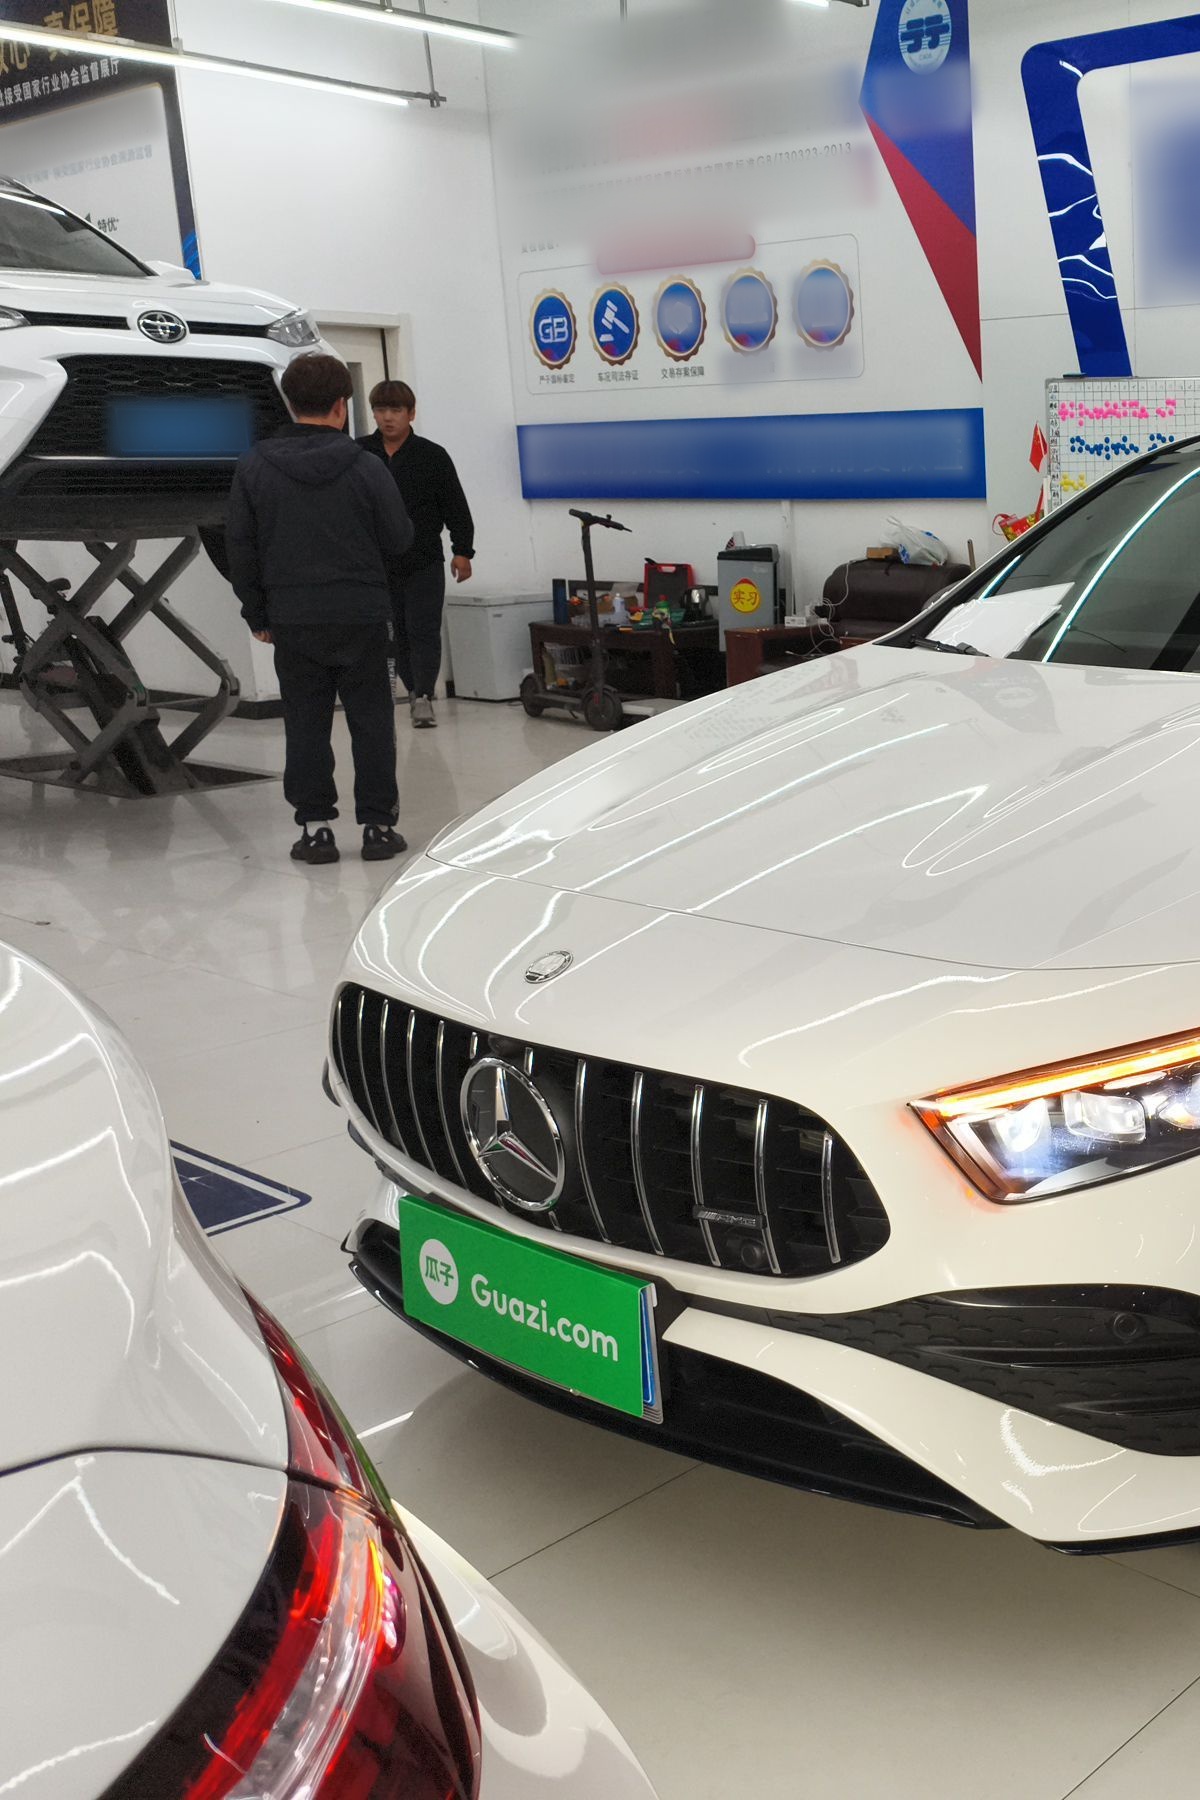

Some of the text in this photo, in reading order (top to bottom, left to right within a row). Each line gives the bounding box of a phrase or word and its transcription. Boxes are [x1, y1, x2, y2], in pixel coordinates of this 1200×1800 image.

[538, 316, 569, 343] GB
[733, 590, 757, 606] 实习
[425, 1255, 454, 1287] 瓜子
[471, 1274, 619, 1362] Guazi.com
